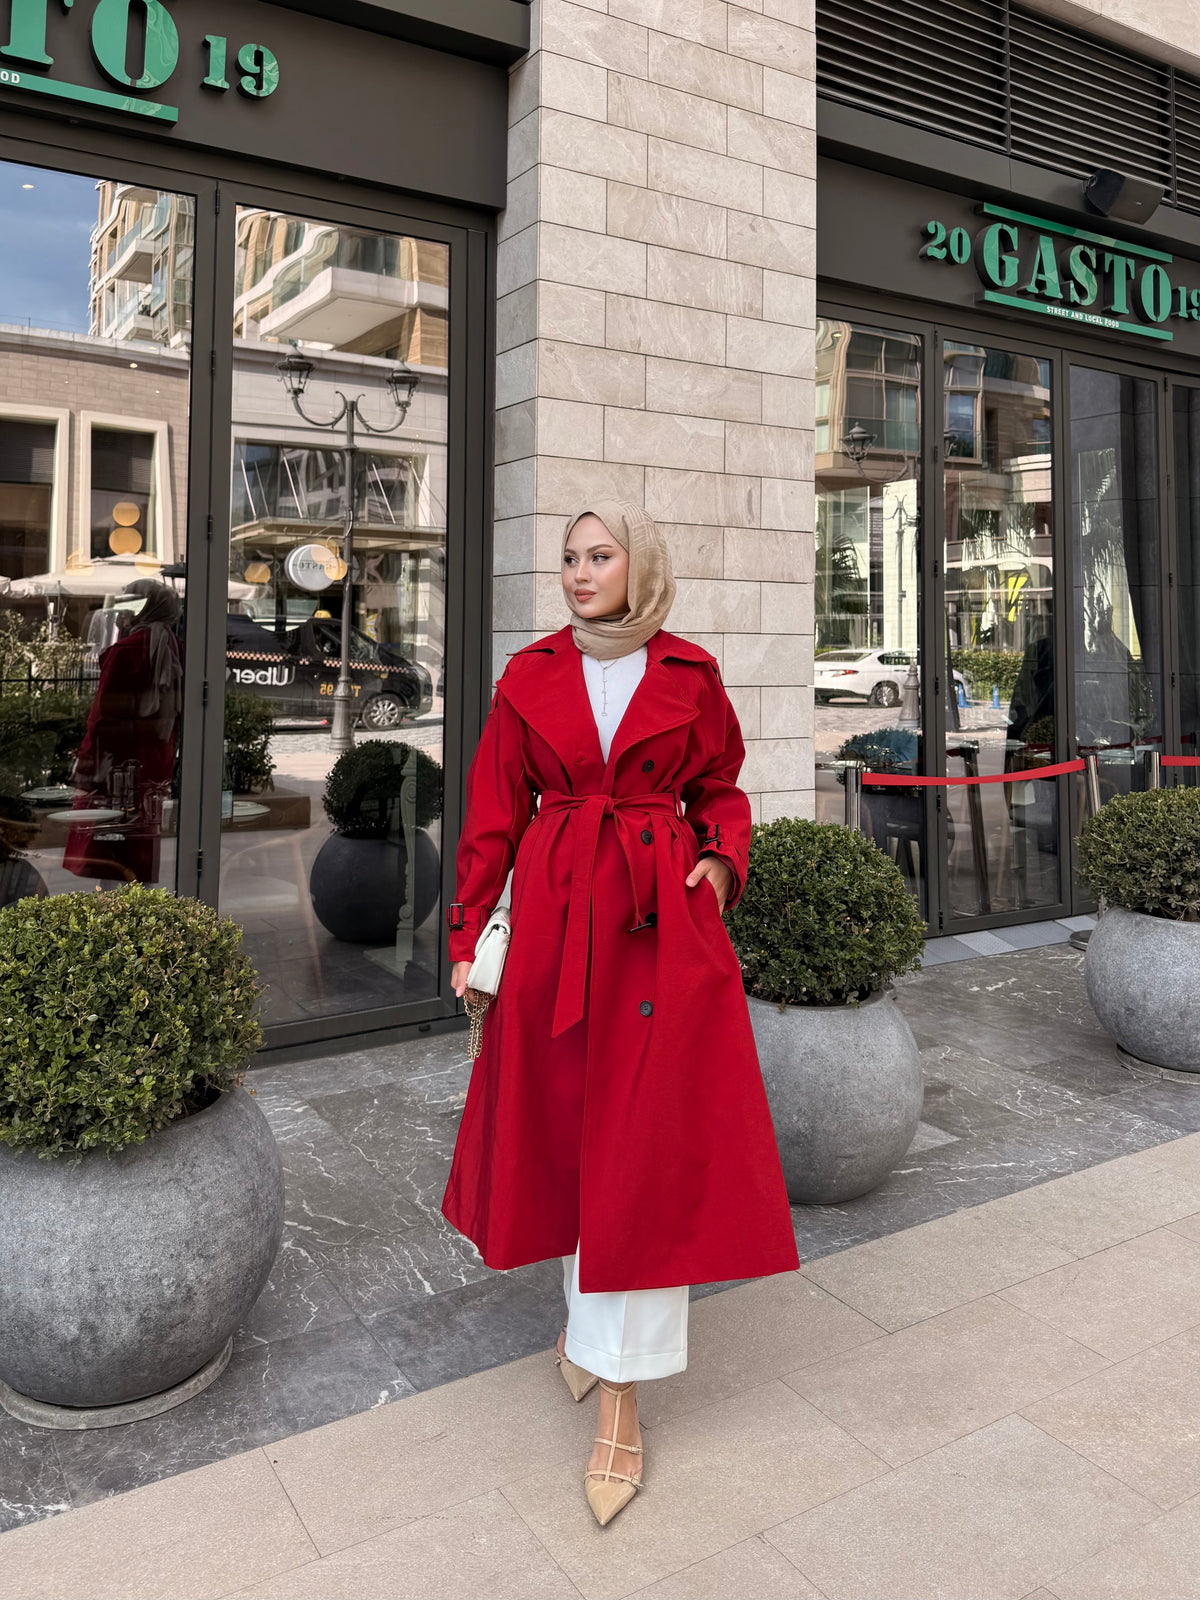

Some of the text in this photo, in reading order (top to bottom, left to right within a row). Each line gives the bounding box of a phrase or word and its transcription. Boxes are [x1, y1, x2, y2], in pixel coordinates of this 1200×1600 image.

[0, 0, 279, 97] TO 19
[0, 70, 20, 84] OD
[926, 220, 1200, 323] 20 GASTO 19
[1046, 306, 1120, 328] STREET AND LOCAL FOOD
